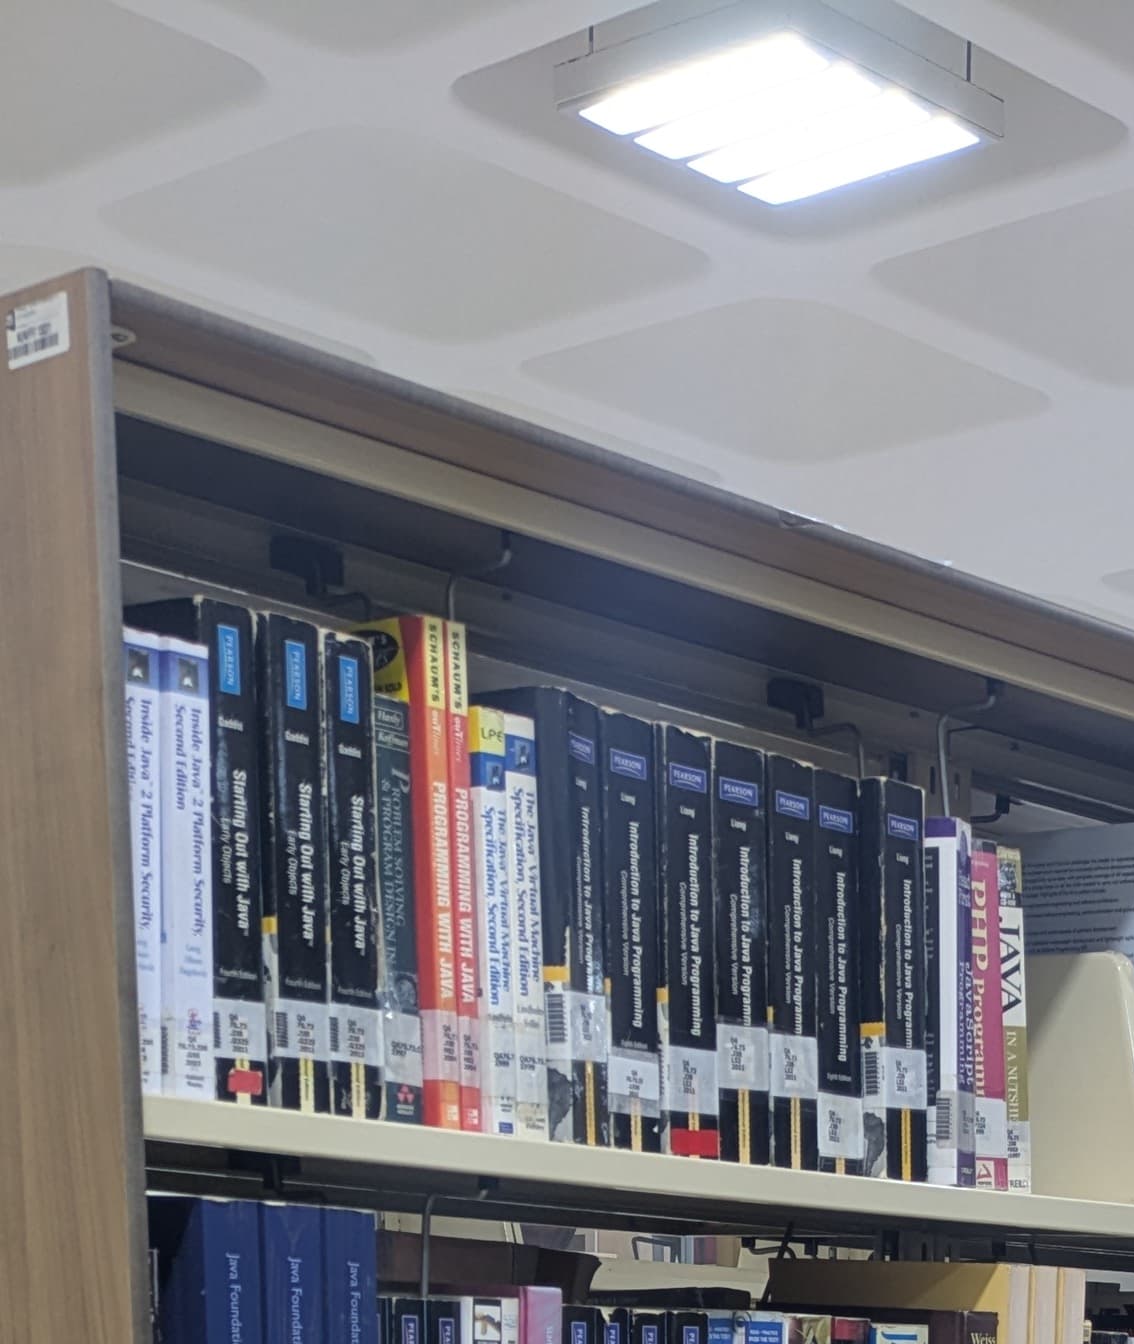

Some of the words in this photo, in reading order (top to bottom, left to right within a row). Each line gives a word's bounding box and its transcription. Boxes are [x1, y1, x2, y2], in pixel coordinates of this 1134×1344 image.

[225, 634, 235, 687] PEARSON
[450, 631, 462, 711] SCHAUM'S
[299, 783, 312, 840] Starting
[301, 843, 314, 869] Out
[455, 787, 471, 911] PROGRAMMING
[687, 834, 700, 911] Introduction
[302, 873, 314, 903] with
[460, 916, 472, 957] WITH
[690, 930, 700, 960] Java
[691, 916, 700, 927] to
[462, 959, 472, 1004] JAVA
[998, 916, 1022, 1018] JAVA
[690, 964, 701, 1037] Programming
[226, 1252, 240, 1279] Java
